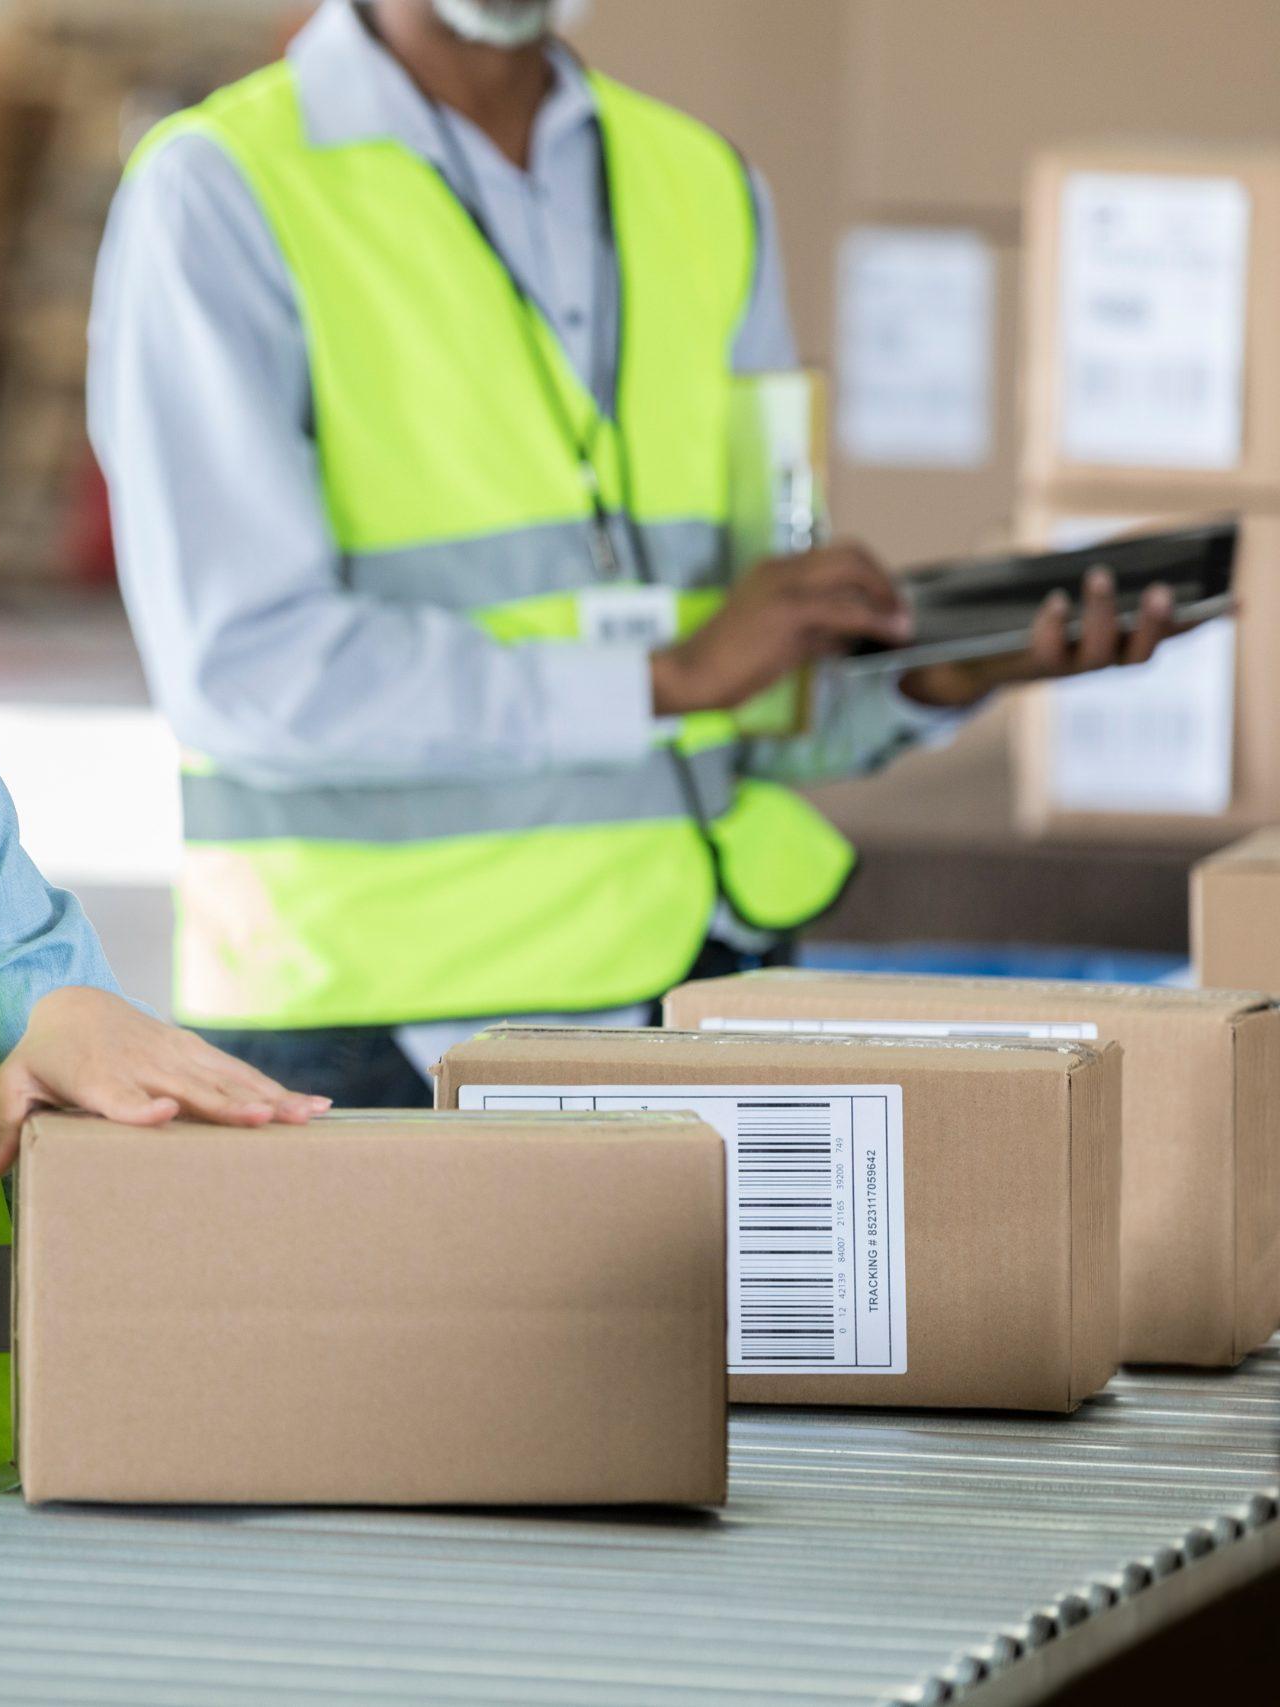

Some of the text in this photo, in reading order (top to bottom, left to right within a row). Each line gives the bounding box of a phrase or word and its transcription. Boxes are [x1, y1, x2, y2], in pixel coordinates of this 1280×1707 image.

[835, 1137, 843, 1153] 749
[836, 1163, 844, 1190] 39200
[837, 1200, 845, 1226] 21165
[867, 1149, 879, 1313] TRACKING # 8523117059642
[837, 1236, 846, 1263] 84007
[838, 1272, 847, 1299] 42139
[839, 1307, 847, 1317] 12
